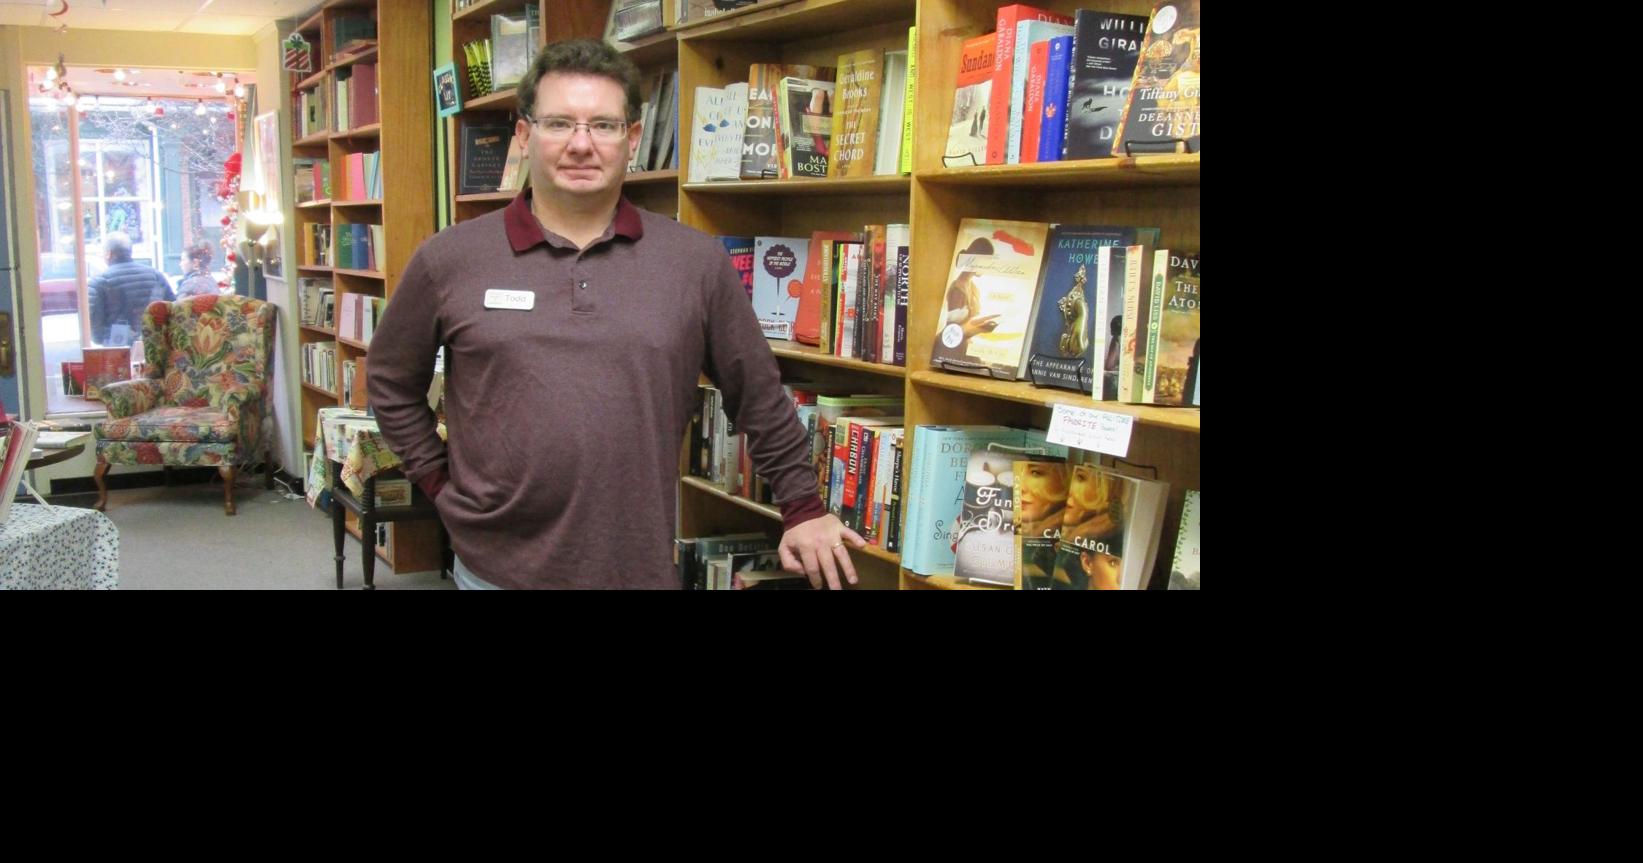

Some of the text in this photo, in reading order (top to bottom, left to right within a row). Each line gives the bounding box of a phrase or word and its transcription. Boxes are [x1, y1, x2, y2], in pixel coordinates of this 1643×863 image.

[995, 18, 1006, 71] GABALDON
[1004, 28, 1013, 60] DIANA
[1139, 88, 1178, 103] Tiffany
[747, 116, 776, 128] ON
[1138, 110, 1200, 122] DEEANNE
[1151, 123, 1200, 137] GIST
[835, 132, 866, 145] SECRET
[833, 148, 864, 161] CHORD
[900, 254, 909, 306] NORTH
[1175, 281, 1198, 294] THE
[1168, 296, 1200, 309] ATO
[1046, 360, 1083, 373] APPEARANE
[1074, 535, 1111, 555] CAROL
